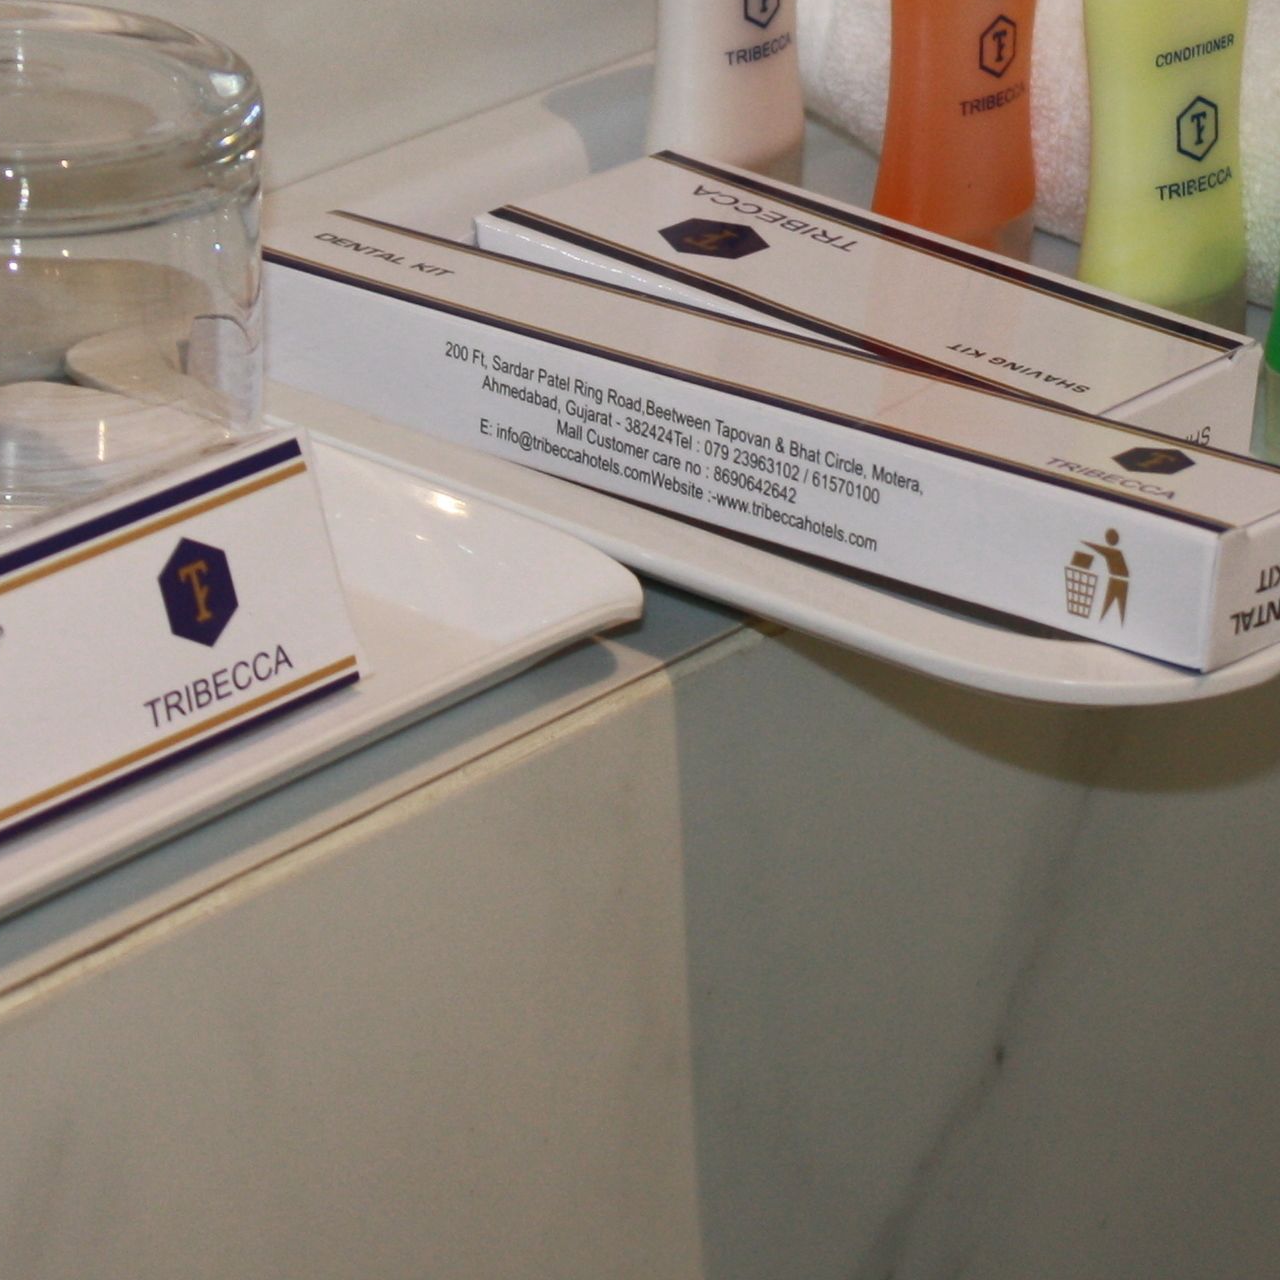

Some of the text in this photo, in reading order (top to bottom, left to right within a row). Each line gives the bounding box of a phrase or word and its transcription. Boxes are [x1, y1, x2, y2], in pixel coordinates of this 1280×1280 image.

[725, 32, 793, 66] TRIBECCA
[1155, 33, 1234, 68] CONDITIONER
[959, 81, 1026, 117] TRIBECCA
[1155, 166, 1233, 201] TRIBECCA
[692, 184, 858, 253] TRIBECCA
[314, 232, 456, 277] DENTAL KIT
[946, 343, 1091, 394] SHAVING KIT
[445, 341, 469, 362] 200
[472, 349, 488, 370] Ft,
[492, 356, 535, 381] Sardar
[538, 368, 570, 392] Patel
[574, 379, 603, 404] Ring
[715, 419, 771, 450] Tapovan
[775, 437, 786, 453] &
[789, 440, 822, 465] Bhat
[824, 451, 867, 479] Circle,
[872, 464, 924, 496] Motera,
[480, 418, 493, 436] E:
[482, 375, 561, 413] Ahmedabad,
[565, 399, 613, 428] Gujarat
[704, 440, 729, 460] 079
[733, 448, 799, 481] 23963102
[812, 470, 880, 504] 61570100
[586, 429, 649, 459] Customer
[652, 451, 681, 470] care
[685, 460, 702, 477] no
[714, 469, 797, 504] 8690642642
[1045, 457, 1177, 500] TRIBECCA
[143, 644, 294, 729] TRIBECCA
